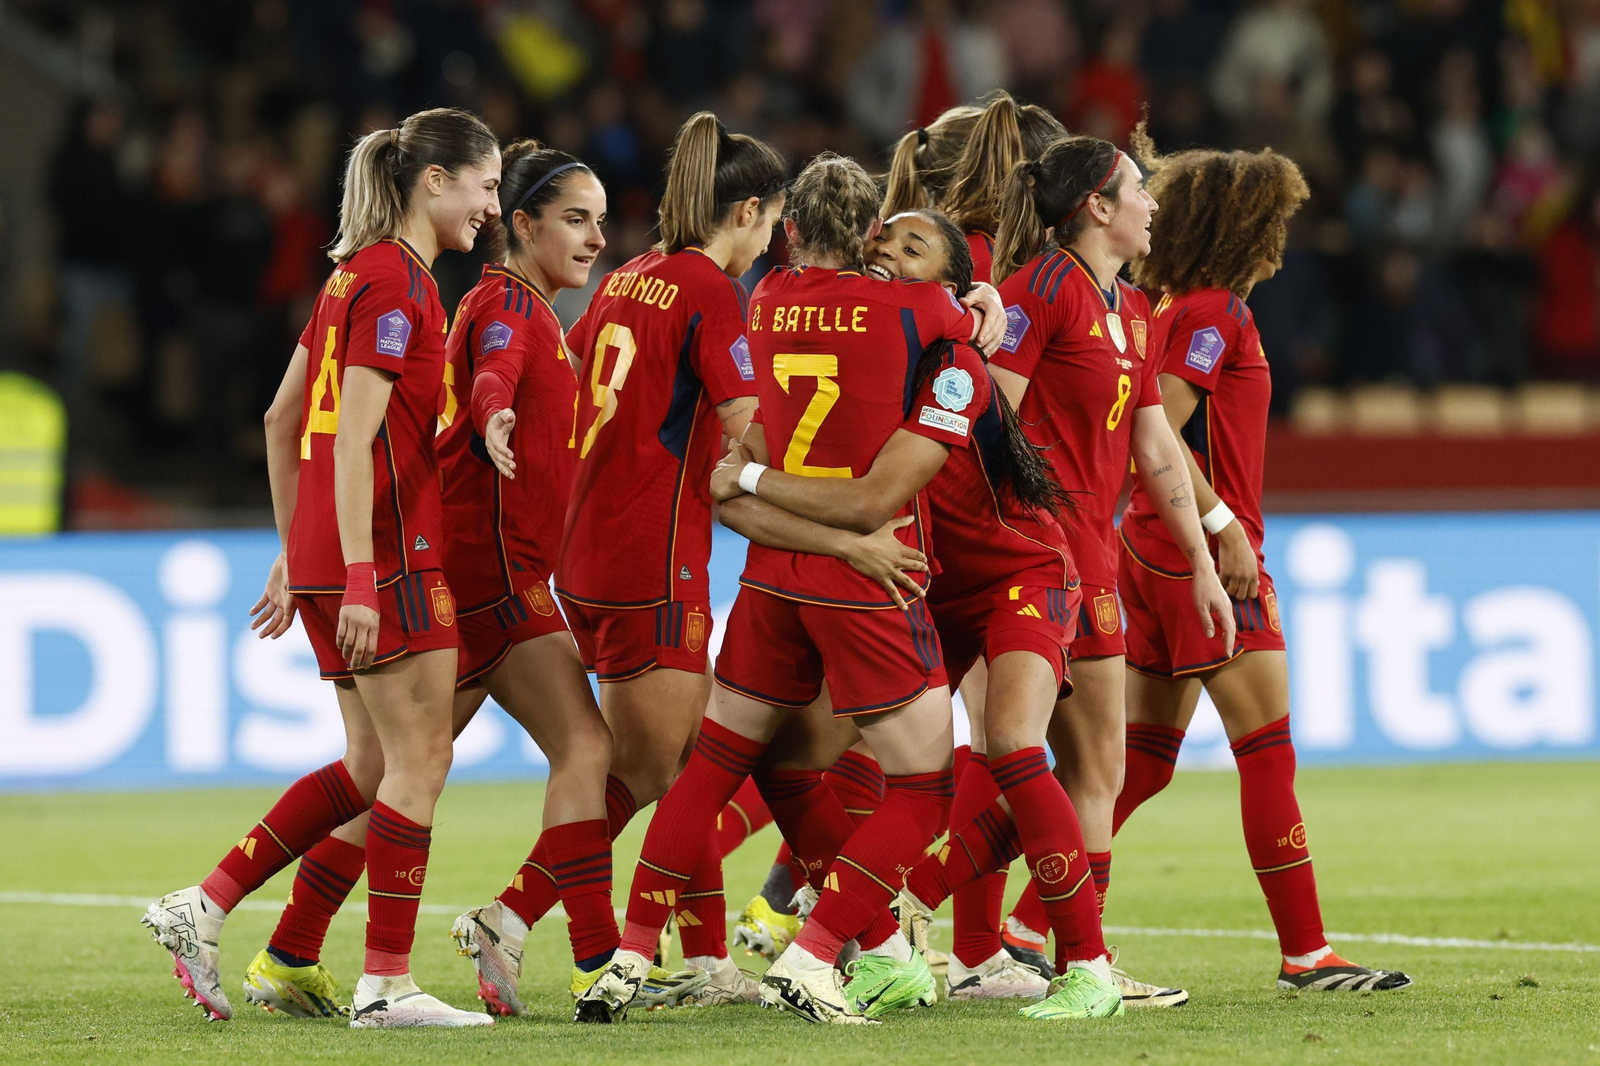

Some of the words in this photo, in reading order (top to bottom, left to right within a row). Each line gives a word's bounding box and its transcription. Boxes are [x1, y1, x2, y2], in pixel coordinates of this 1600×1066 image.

[601, 271, 679, 310] REDONDO
[773, 305, 868, 333] BATLLE
[300, 325, 342, 461] 4
[579, 322, 638, 459] 9
[1106, 374, 1132, 431] 8
[773, 353, 853, 478] 2
[920, 411, 968, 431] FOUNDATION
[1286, 523, 1600, 750] ita
[394, 870, 407, 879] 19
[1068, 849, 1079, 862] 09
